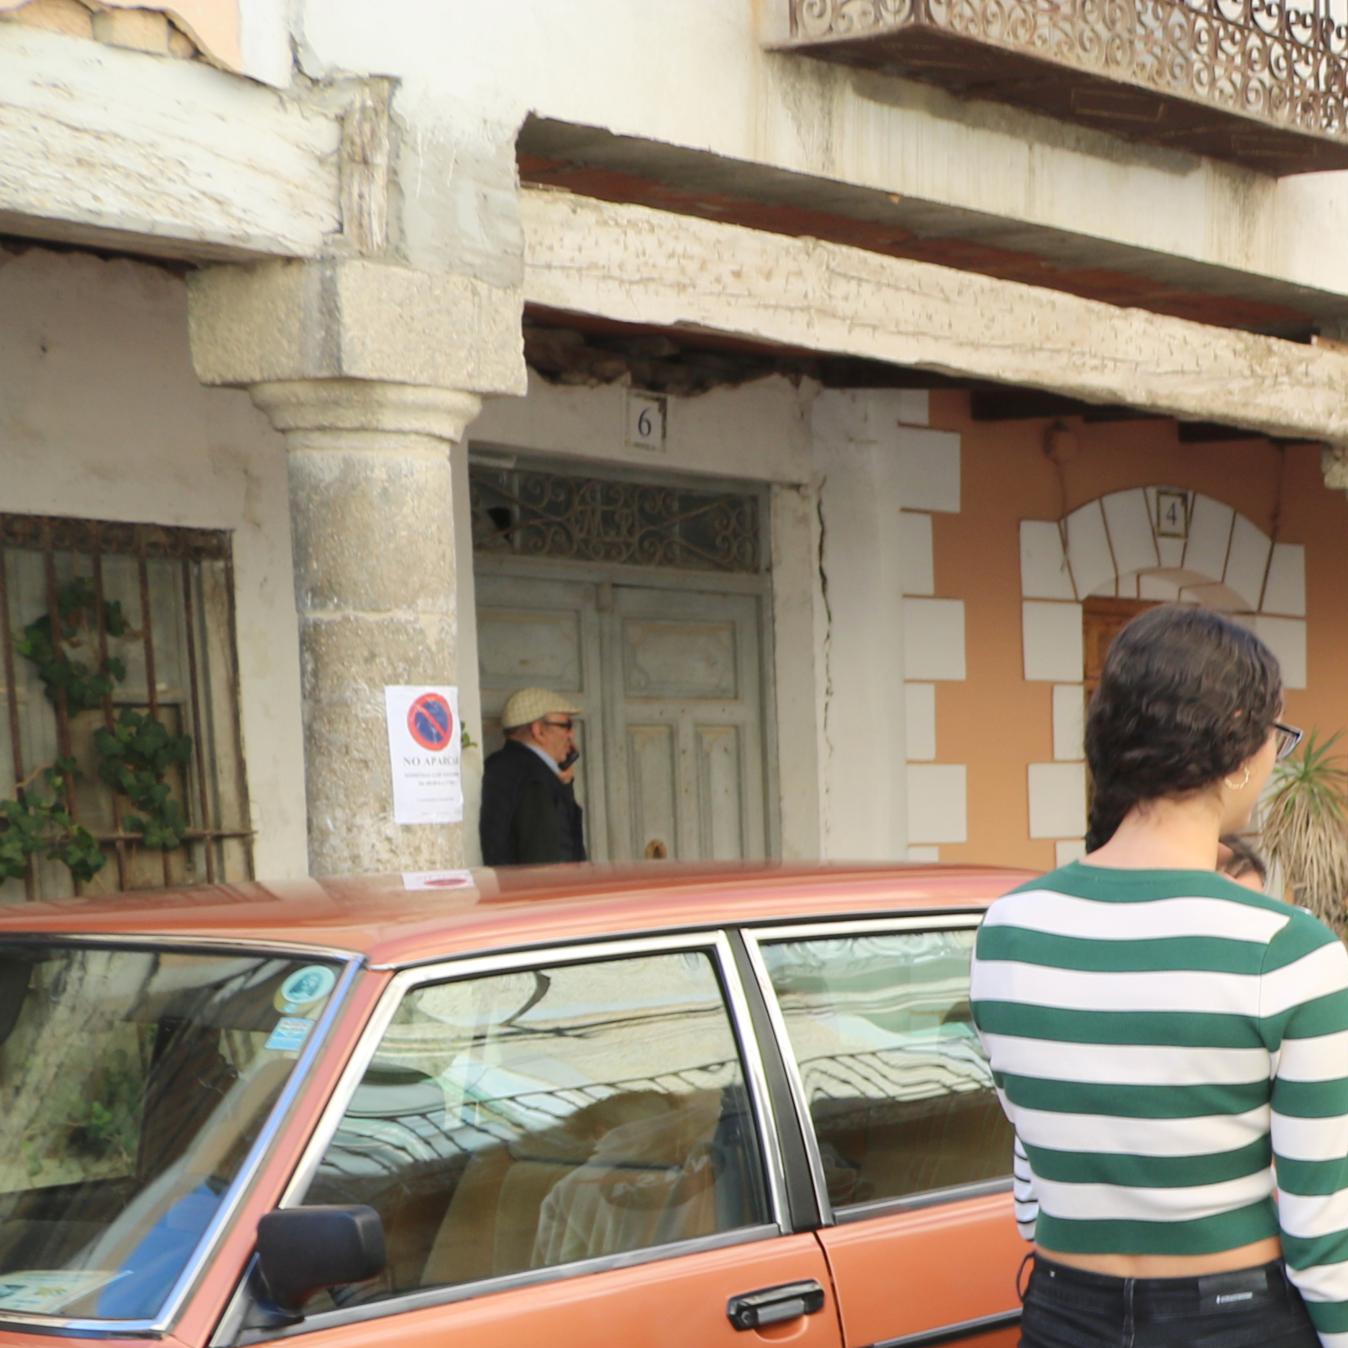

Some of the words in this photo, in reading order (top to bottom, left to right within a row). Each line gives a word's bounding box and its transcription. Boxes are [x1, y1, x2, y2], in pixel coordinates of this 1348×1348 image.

[638, 407, 652, 437] 6
[1166, 502, 1177, 526] 4
[403, 756, 421, 767] NO
